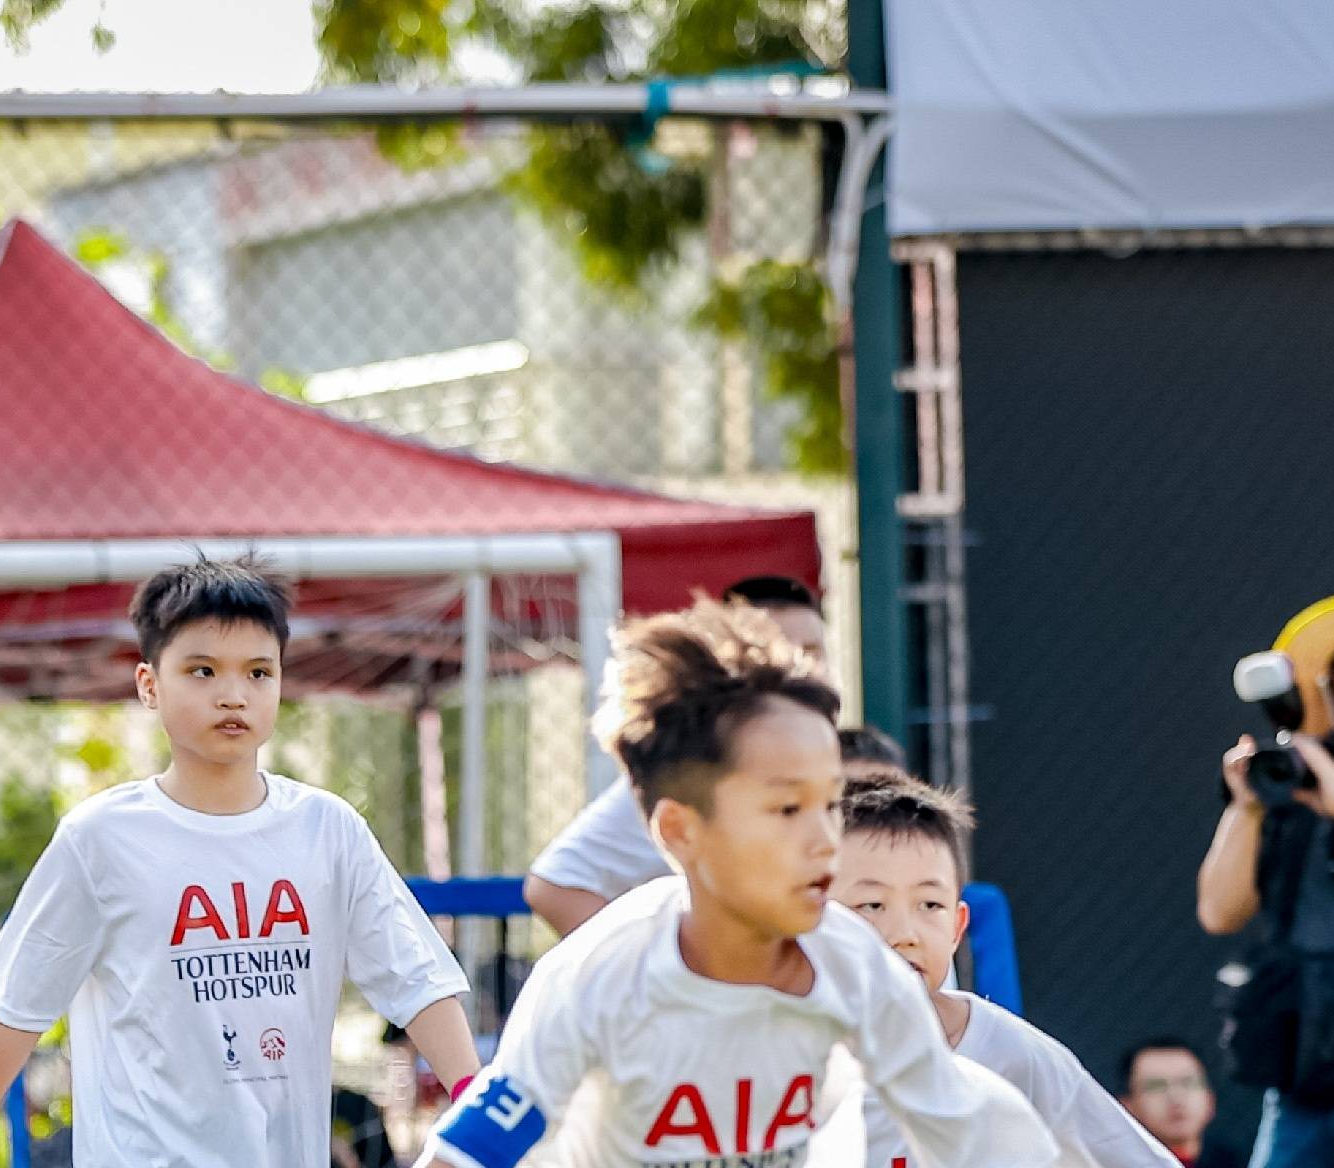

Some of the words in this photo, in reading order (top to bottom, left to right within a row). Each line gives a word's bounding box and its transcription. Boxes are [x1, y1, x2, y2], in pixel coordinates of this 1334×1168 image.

[170, 880, 310, 946] AIA
[170, 948, 312, 980] TOTTENHAM
[192, 973, 298, 1003] HOTSPUR
[644, 1074, 815, 1156] AIA
